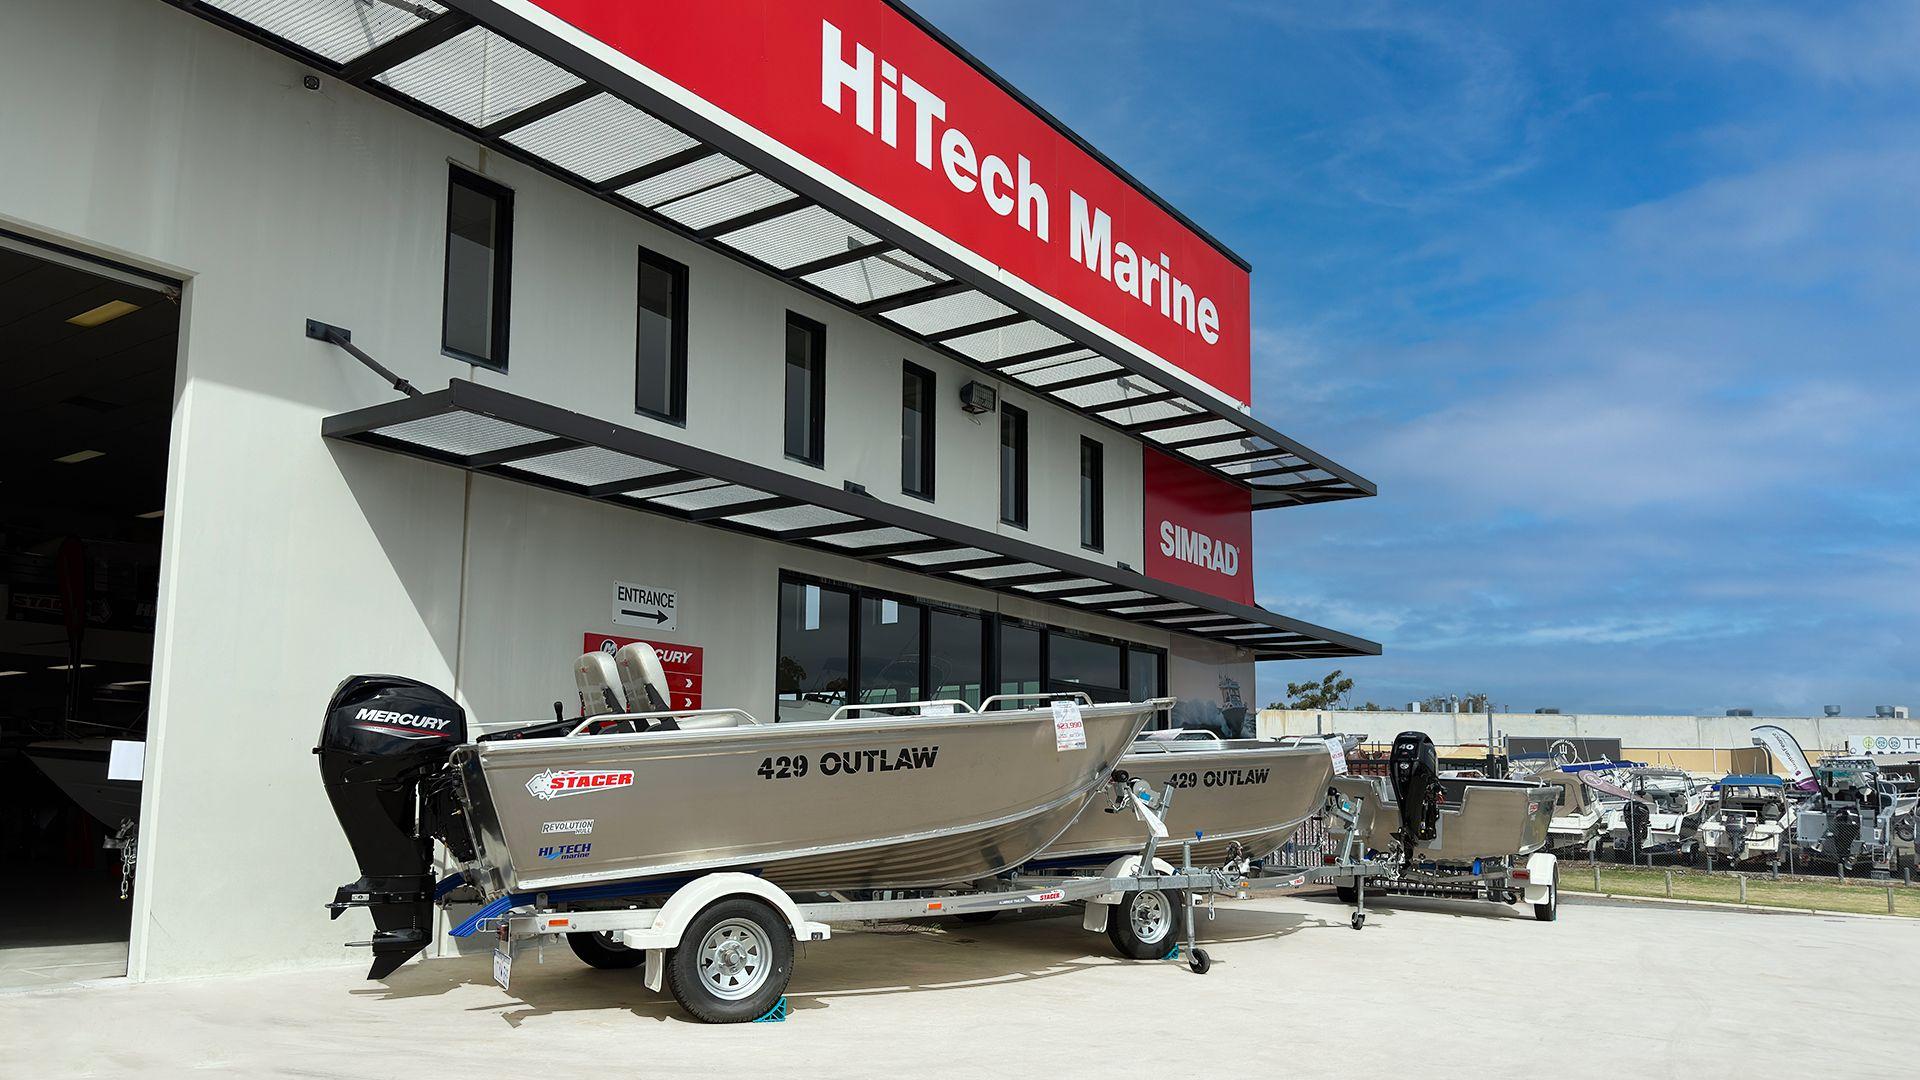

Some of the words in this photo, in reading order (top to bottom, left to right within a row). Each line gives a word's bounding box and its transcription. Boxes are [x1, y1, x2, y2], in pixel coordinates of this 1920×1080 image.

[821, 18, 1050, 244] HiTech
[1069, 189, 1221, 345] Marine
[1160, 519, 1239, 577] SIMRAD
[617, 586, 675, 609] ENTRANCE
[354, 708, 451, 730] MERCURY
[757, 755, 809, 780] 429
[819, 745, 939, 776] OUTLAW
[550, 773, 633, 789] STACER
[1169, 772, 1198, 789] 429
[1203, 768, 1270, 787] OUTLAW
[542, 821, 593, 833] REVOLUTION
[558, 843, 592, 854] TECH
[561, 852, 590, 860] marine
